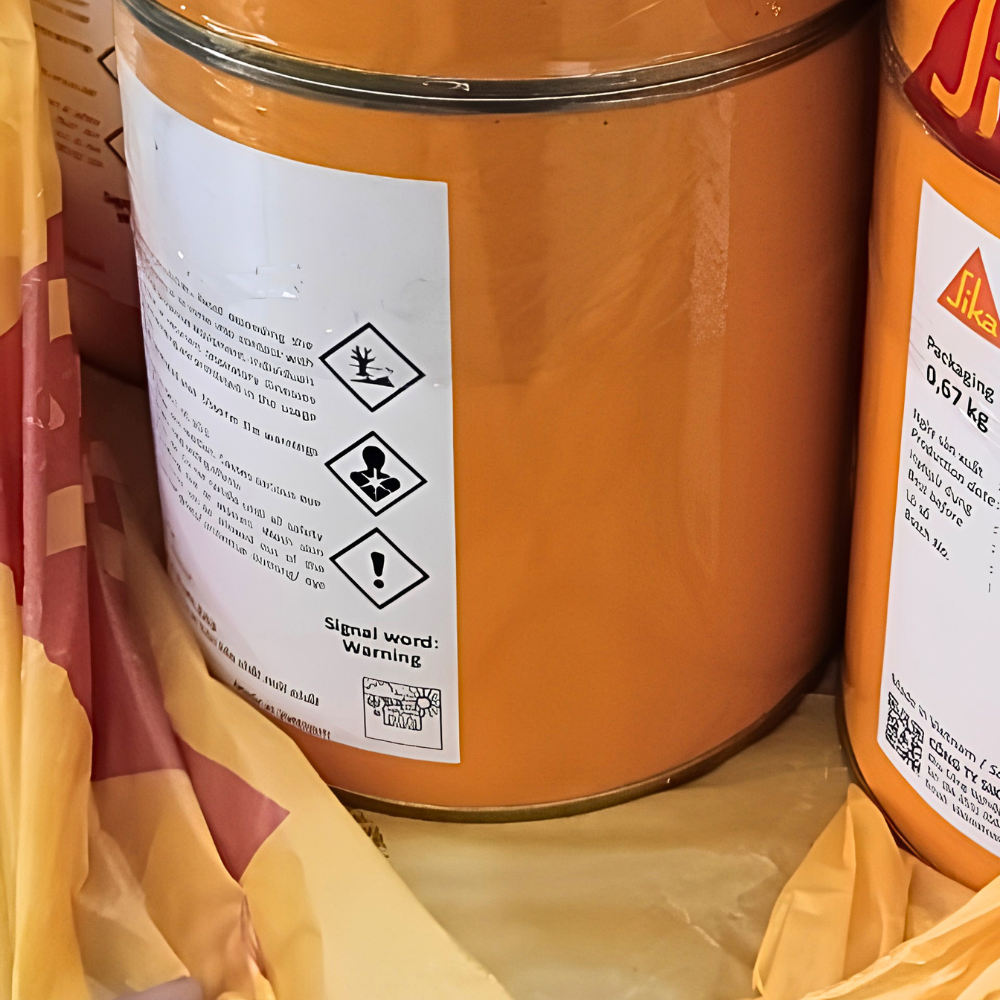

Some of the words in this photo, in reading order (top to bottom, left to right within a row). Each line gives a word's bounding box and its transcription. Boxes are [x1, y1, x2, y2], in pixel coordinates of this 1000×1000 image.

[947, 269, 998, 338] Sika
[926, 364, 962, 408] 0,67
[967, 396, 990, 433] kg
[927, 335, 995, 404] Packaging
[324, 616, 377, 640] Signal
[384, 630, 439, 650] word:
[342, 639, 421, 668] Warning
